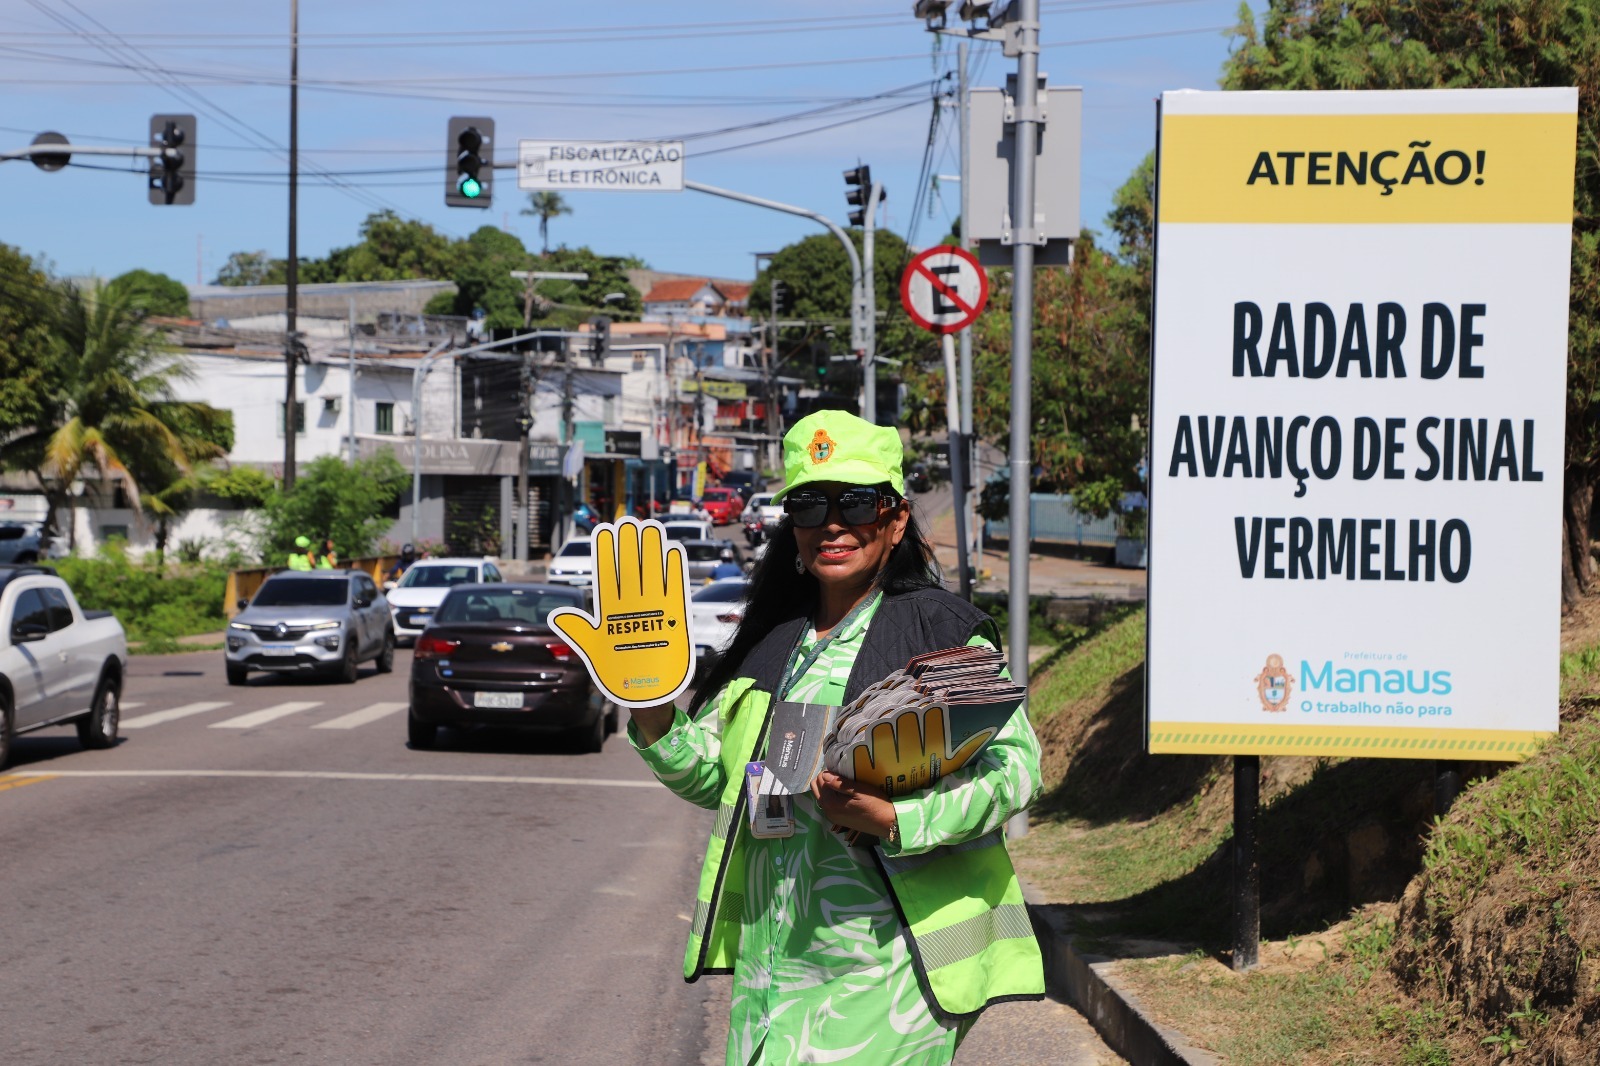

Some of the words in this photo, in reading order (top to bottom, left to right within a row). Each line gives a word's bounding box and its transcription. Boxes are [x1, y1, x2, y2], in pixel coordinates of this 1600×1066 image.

[549, 144, 680, 165] FISCALIZAÇÃO
[547, 168, 661, 185] ELETRÔNICA
[1246, 140, 1487, 196] ATENÇÃO!
[1232, 301, 1407, 379] RADAR
[1420, 302, 1486, 379] DE
[403, 444, 470, 459] MOLINA
[1168, 415, 1342, 498] AVANÇO
[1352, 416, 1406, 481] DE
[1414, 416, 1544, 482] SINAL
[1234, 516, 1472, 583] VERMELHO
[1344, 651, 1393, 661] Prefeitura
[1396, 652, 1408, 661] de
[630, 677, 660, 685] Manaus
[1300, 660, 1453, 695] Manaus
[1301, 700, 1313, 712] O
[1316, 701, 1382, 714] trabalho
[1386, 702, 1414, 715] não
[1418, 704, 1452, 718] para
[781, 739, 795, 768] Manaus
